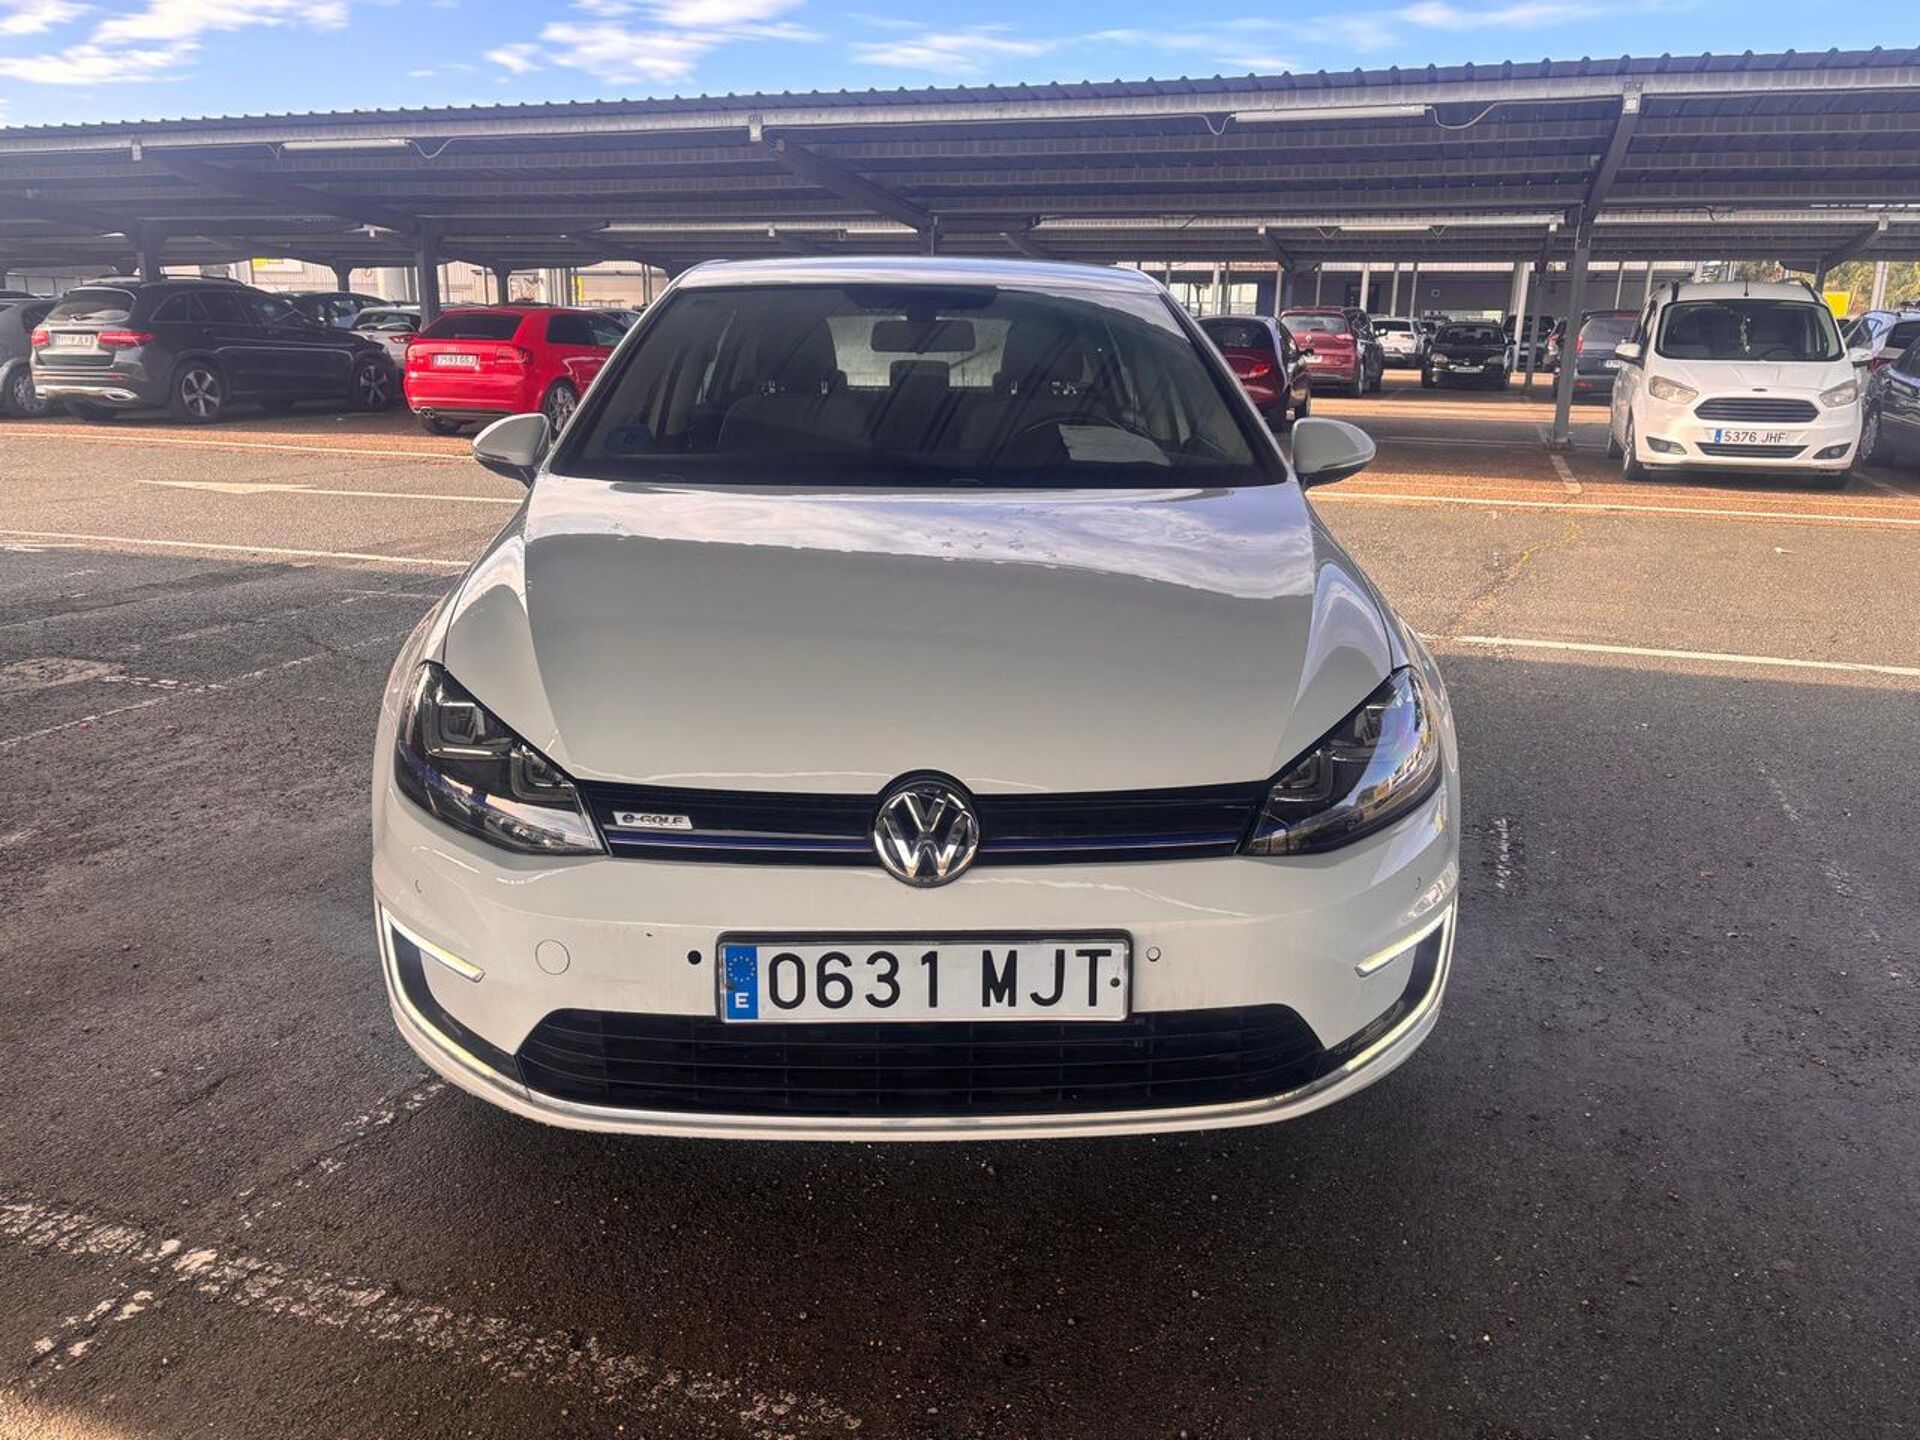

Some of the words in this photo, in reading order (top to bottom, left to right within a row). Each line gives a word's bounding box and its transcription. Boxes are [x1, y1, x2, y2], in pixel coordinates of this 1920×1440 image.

[1724, 431, 1757, 443] 5376
[1761, 432, 1786, 444] JHF
[768, 950, 939, 1010] 0631
[982, 949, 1112, 1007] MJT
[735, 992, 749, 1009] E
